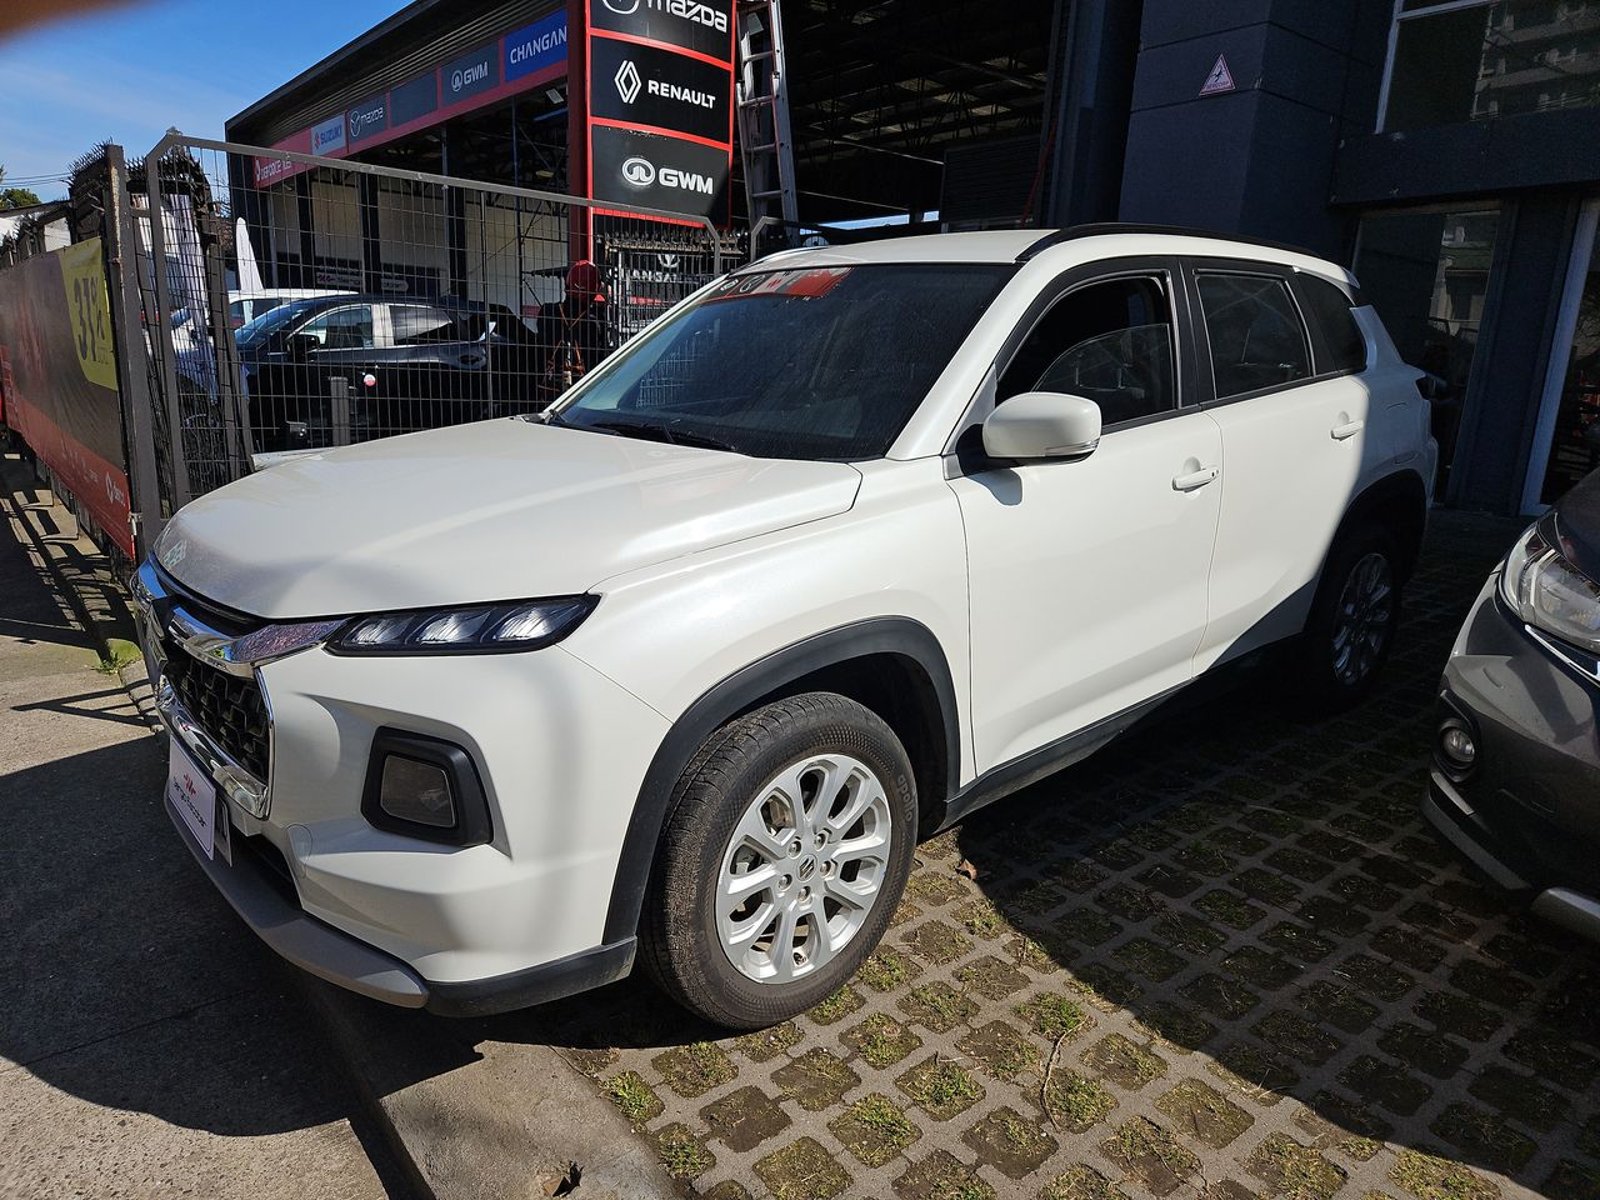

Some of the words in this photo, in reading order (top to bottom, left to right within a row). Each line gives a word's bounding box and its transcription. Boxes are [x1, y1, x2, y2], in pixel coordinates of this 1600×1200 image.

[510, 25, 567, 64] CHANGAN
[464, 61, 488, 85] GWM
[648, 80, 716, 109] RENAULT
[320, 124, 342, 145] SUZUKI
[658, 168, 713, 194] GWM
[897, 774, 914, 822] apollo
